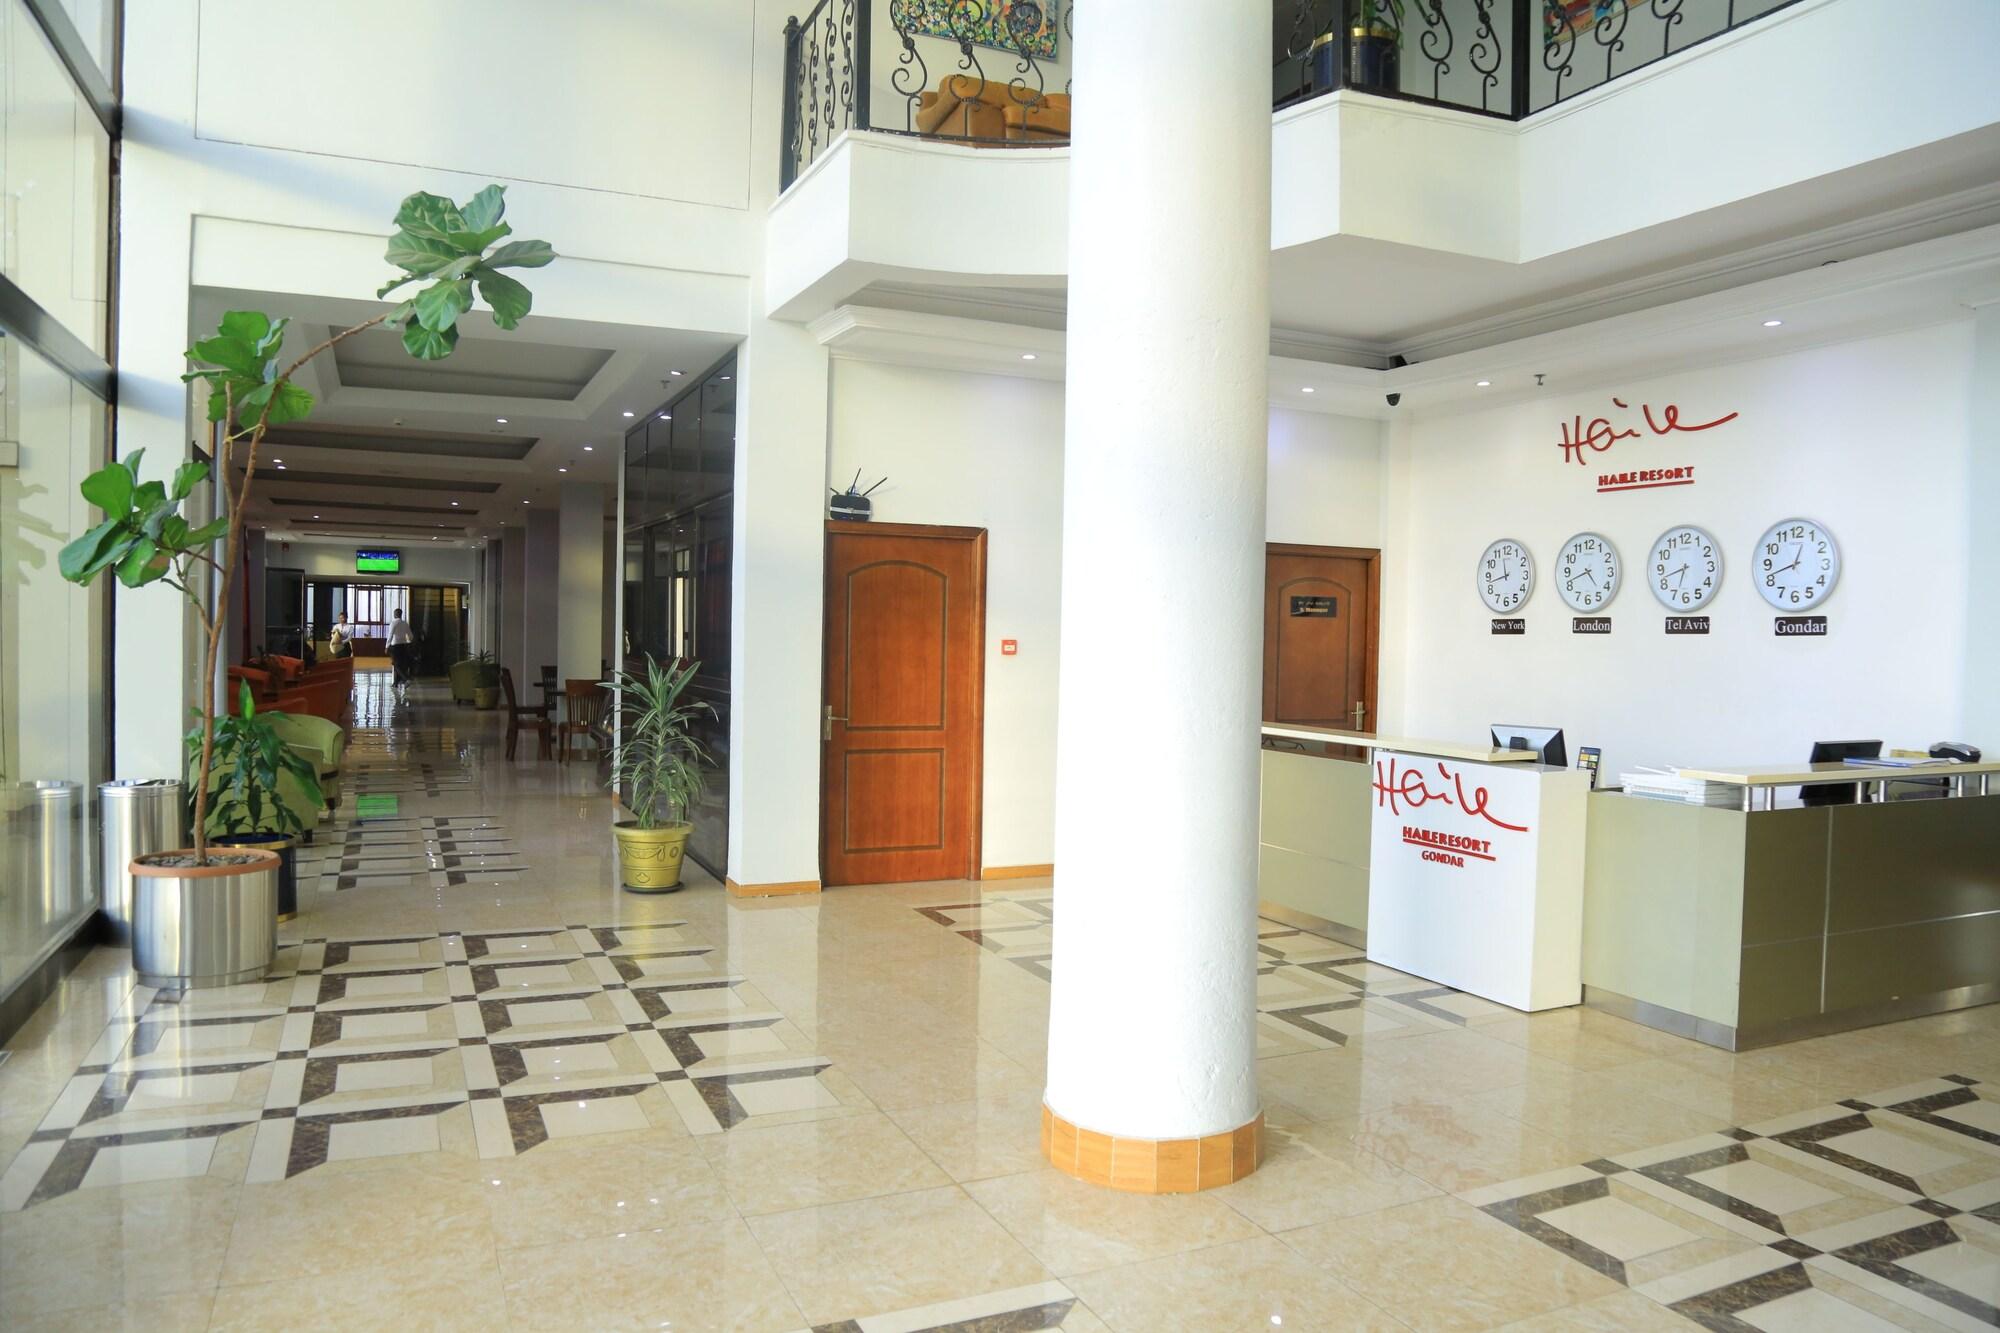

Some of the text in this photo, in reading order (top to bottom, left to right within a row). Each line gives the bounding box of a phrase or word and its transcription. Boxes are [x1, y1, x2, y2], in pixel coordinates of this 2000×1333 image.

[1558, 397, 1739, 466] Haile
[1639, 467, 1695, 482] RESORT
[1776, 531, 1787, 542] 11
[1790, 526, 1804, 538] 12
[1667, 538, 1676, 549] 11
[1679, 533, 1691, 544] 12
[1503, 545, 1512, 555] 12
[1575, 544, 1581, 553] 11
[1584, 540, 1594, 550] 12
[1766, 543, 1779, 555] 10
[1818, 541, 1827, 553] 2
[1494, 549, 1500, 558] 11
[1659, 549, 1670, 560] 10
[1704, 546, 1711, 557] 2
[1521, 557, 1526, 567] 2
[1566, 554, 1576, 564] 10
[1605, 553, 1611, 563] 2
[1487, 560, 1495, 569] 10
[1657, 564, 1664, 575] 9
[1707, 561, 1715, 572] 3
[1764, 559, 1772, 571] 9
[1821, 559, 1830, 570] 3
[1486, 572, 1491, 582] 9
[1523, 571, 1528, 580] 3
[1564, 567, 1570, 577] 9
[1608, 567, 1614, 577] 3
[1567, 581, 1573, 591] 8
[1604, 581, 1610, 591] 4
[1661, 579, 1668, 590] 8
[1704, 576, 1711, 587] 4
[1766, 575, 1775, 587] 8
[1816, 575, 1825, 586] 4
[1488, 585, 1493, 594] 8
[1520, 584, 1525, 593] 4
[1777, 587, 1785, 598] 7
[1805, 587, 1814, 598] 5
[1495, 594, 1500, 603] 7
[1513, 594, 1518, 603] 5
[1575, 592, 1581, 601] 7
[1585, 595, 1591, 605] 6
[1596, 592, 1601, 601] 5
[1671, 590, 1677, 600] 7
[1682, 592, 1689, 603] 6
[1695, 589, 1702, 600] 5
[1791, 591, 1799, 603] 6
[1504, 597, 1509, 606] 6
[1492, 621, 1525, 630] New York
[1573, 619, 1611, 631] London
[1665, 619, 1710, 630] Tel Aviv
[1775, 620, 1826, 633] Gondar
[1372, 758, 1528, 832] Haile
[1421, 850, 1464, 868] GONDAR
